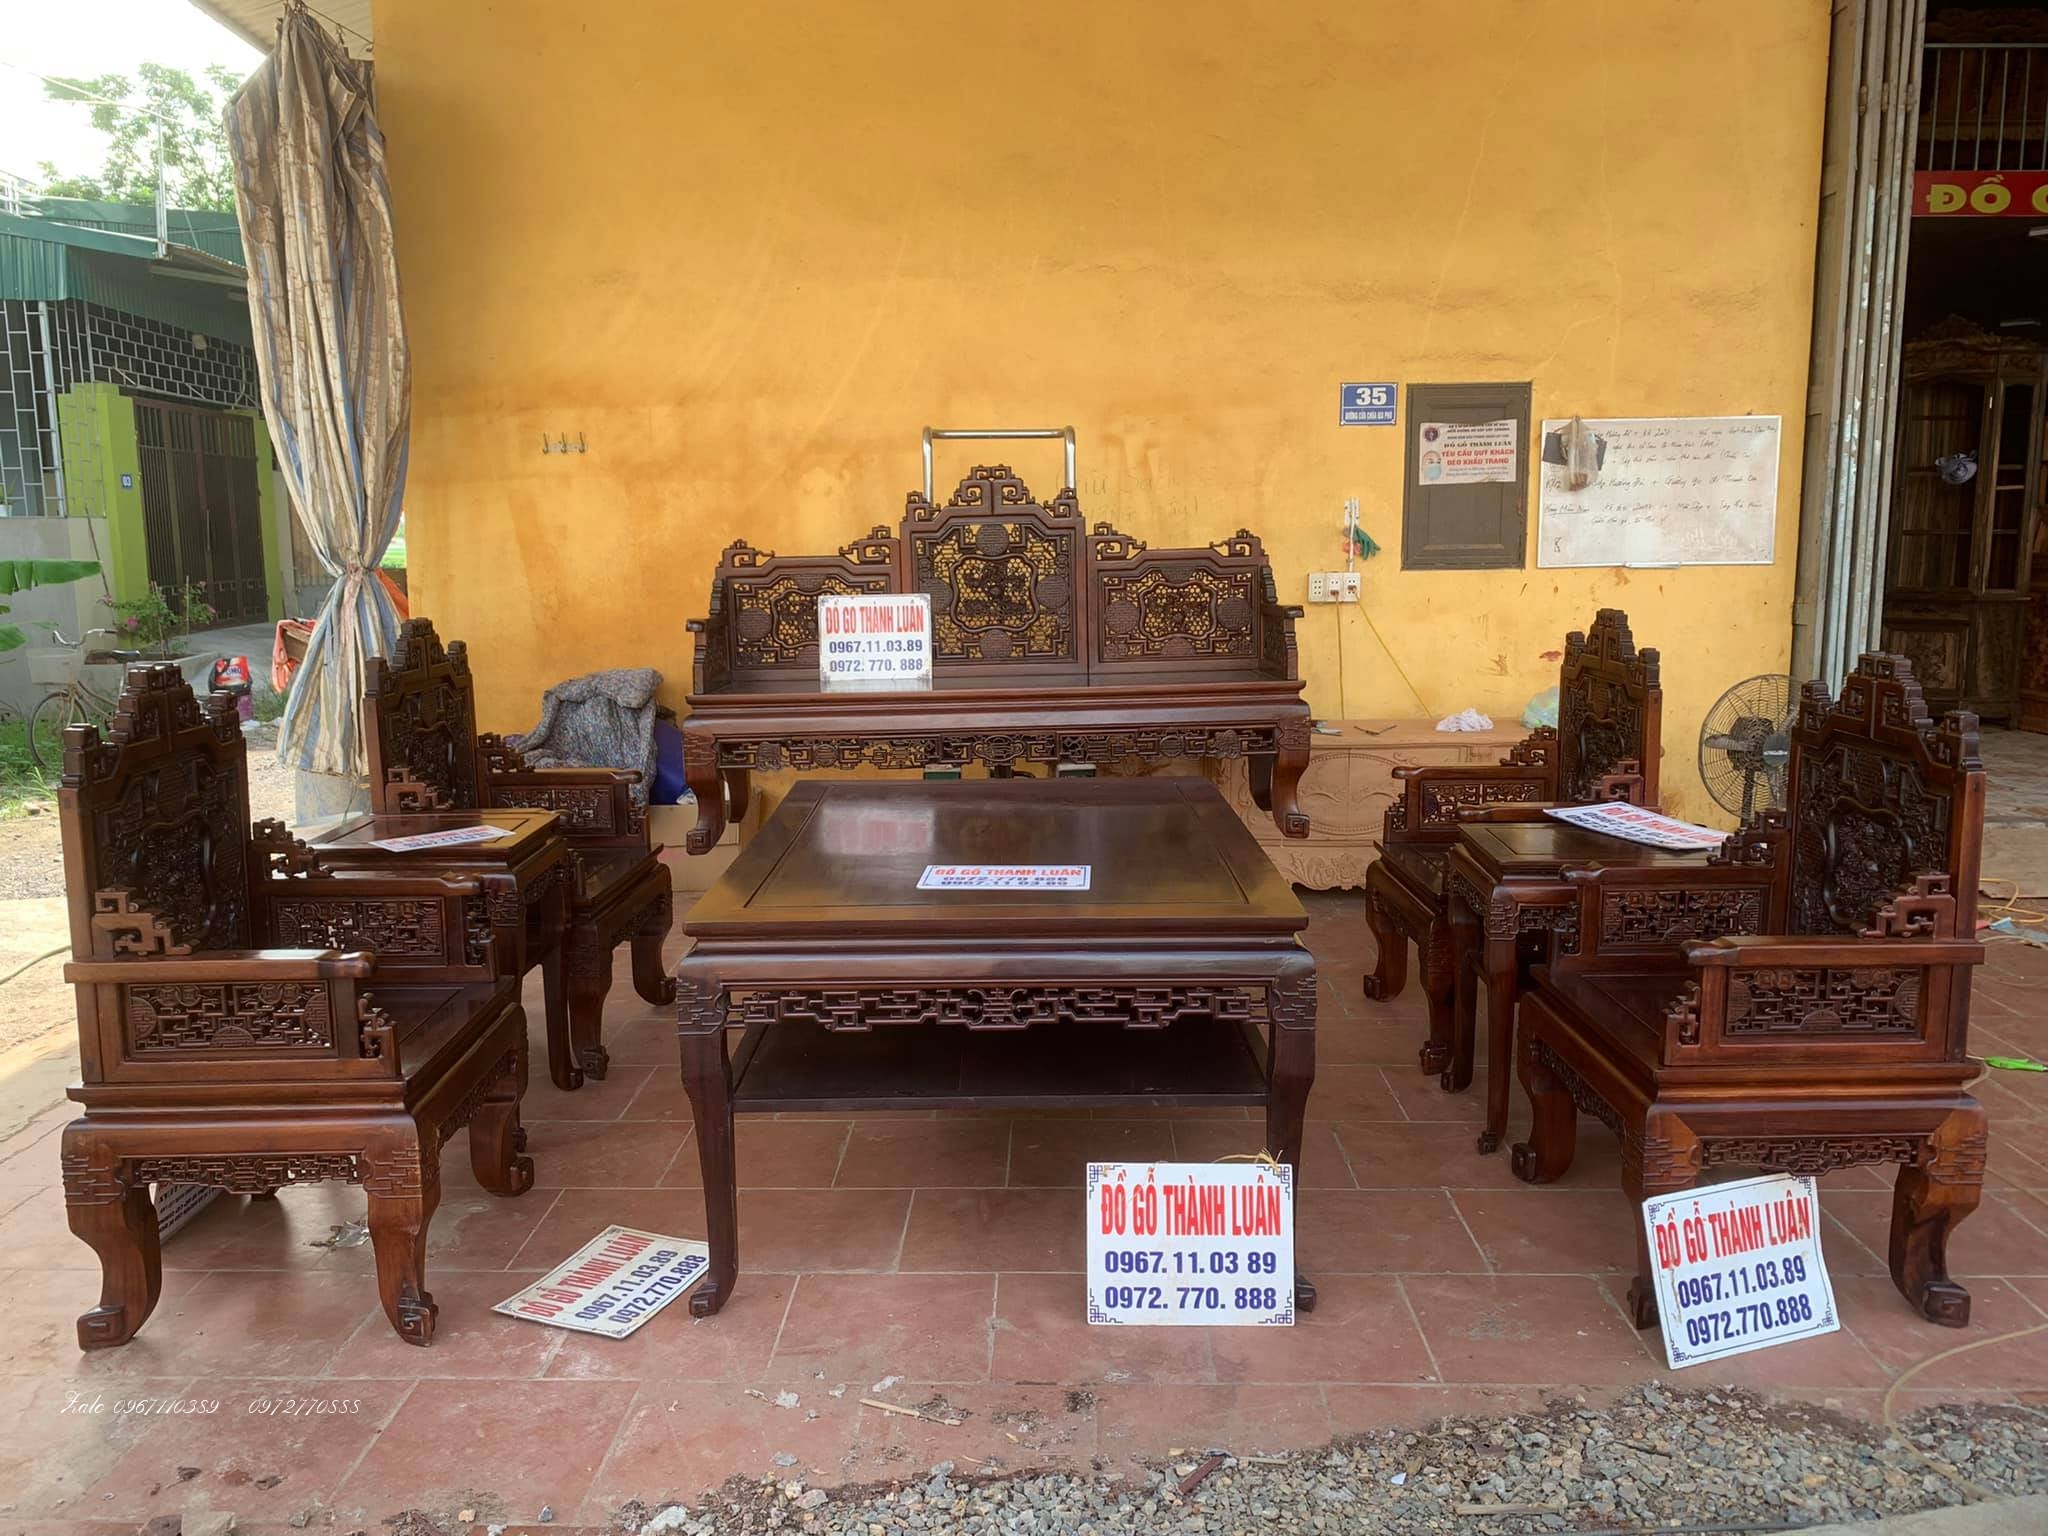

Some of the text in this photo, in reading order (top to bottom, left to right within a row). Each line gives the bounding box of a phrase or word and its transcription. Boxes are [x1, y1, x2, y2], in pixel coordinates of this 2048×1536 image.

[1356, 387, 1387, 405] 35
[829, 639, 923, 654] 0967.11.03.89
[900, 658, 923, 671] 888
[1101, 1167, 1281, 1236] ĐỒ GỖ THÀNH LUÂN
[1655, 1190, 1812, 1269] ĐỒ GỖ THÀNH LUÂN
[558, 1256, 624, 1290] THÀNH
[598, 1233, 657, 1262] LUÂN
[575, 1249, 679, 1321] 0967.11.03.89
[1678, 1254, 1807, 1308] 0967.11.03.89
[608, 1254, 707, 1324] 0972.770.888
[1235, 1287, 1277, 1309] 888
[1686, 1293, 1813, 1347] 0972.770.888
